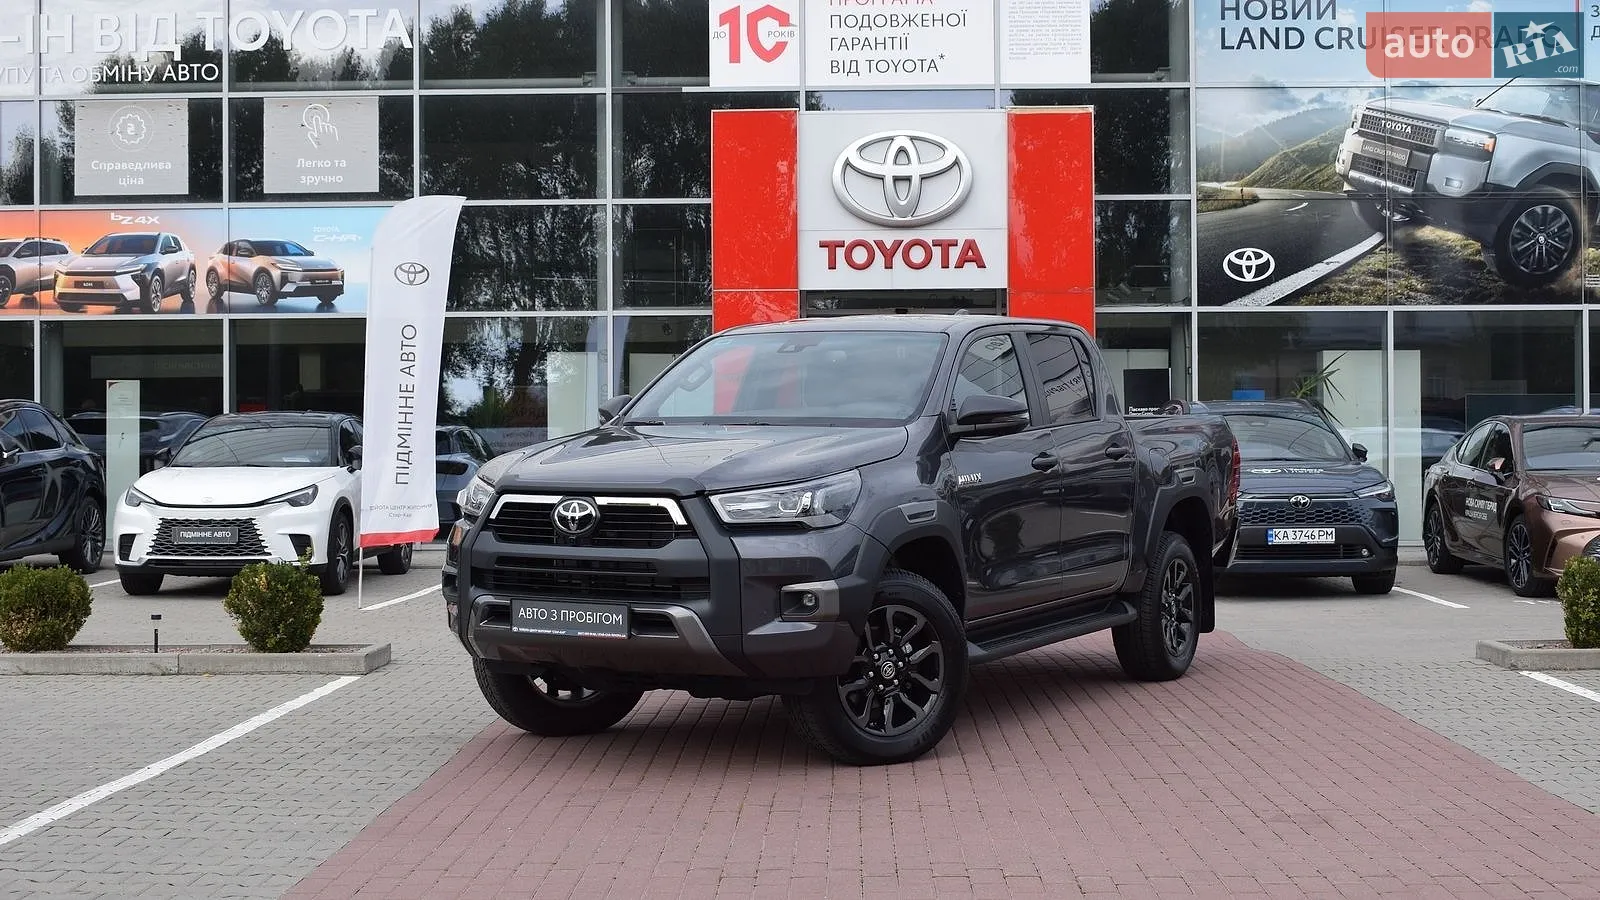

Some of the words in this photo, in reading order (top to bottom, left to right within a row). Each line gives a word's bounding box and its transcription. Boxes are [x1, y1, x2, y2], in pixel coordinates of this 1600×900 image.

[830, 9, 968, 31] ПОДОВЖЕНОЇ
[94, 12, 182, 61] ВІД
[196, 8, 414, 51] TOYOTA
[712, 30, 727, 40] ДО
[767, 30, 795, 38] РОКІВ
[830, 32, 910, 51] ГАРАНТІЇ
[1220, 26, 1305, 50] LAND
[71, 64, 156, 82] ОБМІНУ
[162, 63, 219, 81] АВТО
[830, 60, 860, 76] ВІД
[1382, 120, 1412, 134] TOYOTA
[91, 160, 172, 172] Справедлива
[296, 158, 331, 168] Легко
[334, 160, 346, 168] та
[119, 175, 144, 187] ціна
[299, 175, 344, 186] зручно
[818, 238, 987, 271] TOYOTA
[399, 324, 417, 378] АВТО
[395, 383, 415, 485] ПІДМІННЕ
[180, 531, 212, 539] ПІДМІННЕ
[1274, 530, 1290, 541] KA
[1291, 530, 1316, 541] 3746
[1317, 529, 1334, 540] PM
[518, 607, 548, 620] АВТО
[550, 609, 558, 621] З
[560, 610, 623, 625] ПРОБІГОМ
